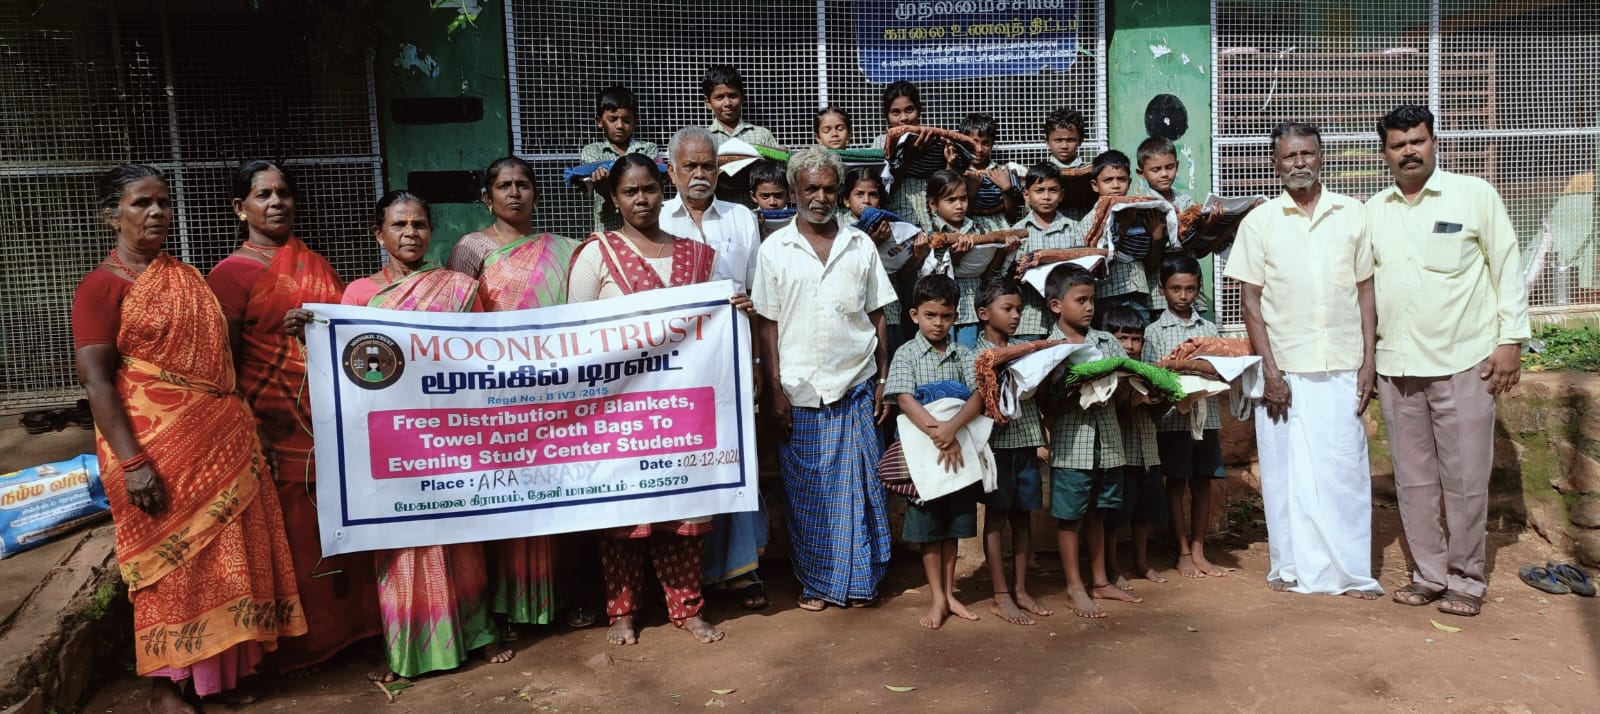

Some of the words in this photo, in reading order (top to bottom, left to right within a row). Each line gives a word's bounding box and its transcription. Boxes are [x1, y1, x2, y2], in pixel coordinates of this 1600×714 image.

[884, 26, 944, 40] காலை
[950, 18, 1024, 38] உணவுத்
[409, 331, 592, 362] MOONKIL
[590, 313, 712, 352] TRUST
[421, 361, 569, 395] மூங்கில்
[577, 350, 683, 388] டிரஸ்ட்
[393, 415, 441, 430] Free
[448, 408, 568, 427] Distribution
[574, 402, 597, 418] Of
[604, 396, 695, 414] Blankets,
[487, 395, 517, 406] Regd
[520, 394, 536, 403] No
[546, 391, 554, 401] B
[579, 386, 609, 398] /2015
[420, 431, 482, 449] Towel
[489, 429, 529, 445] And
[535, 420, 588, 440] Cloth
[594, 418, 644, 436] Bags
[648, 414, 673, 430] To
[388, 453, 472, 473] Evening
[479, 447, 537, 465] Study
[543, 441, 611, 458] Center
[616, 432, 704, 453] Students
[640, 458, 673, 471] Date
[394, 498, 466, 513] மேகமலை
[470, 490, 525, 506] கிராமம்,
[527, 486, 562, 500] தேனி
[565, 479, 628, 497] மாவட்டம்
[639, 475, 689, 488] 625579
[421, 480, 464, 491] Place
